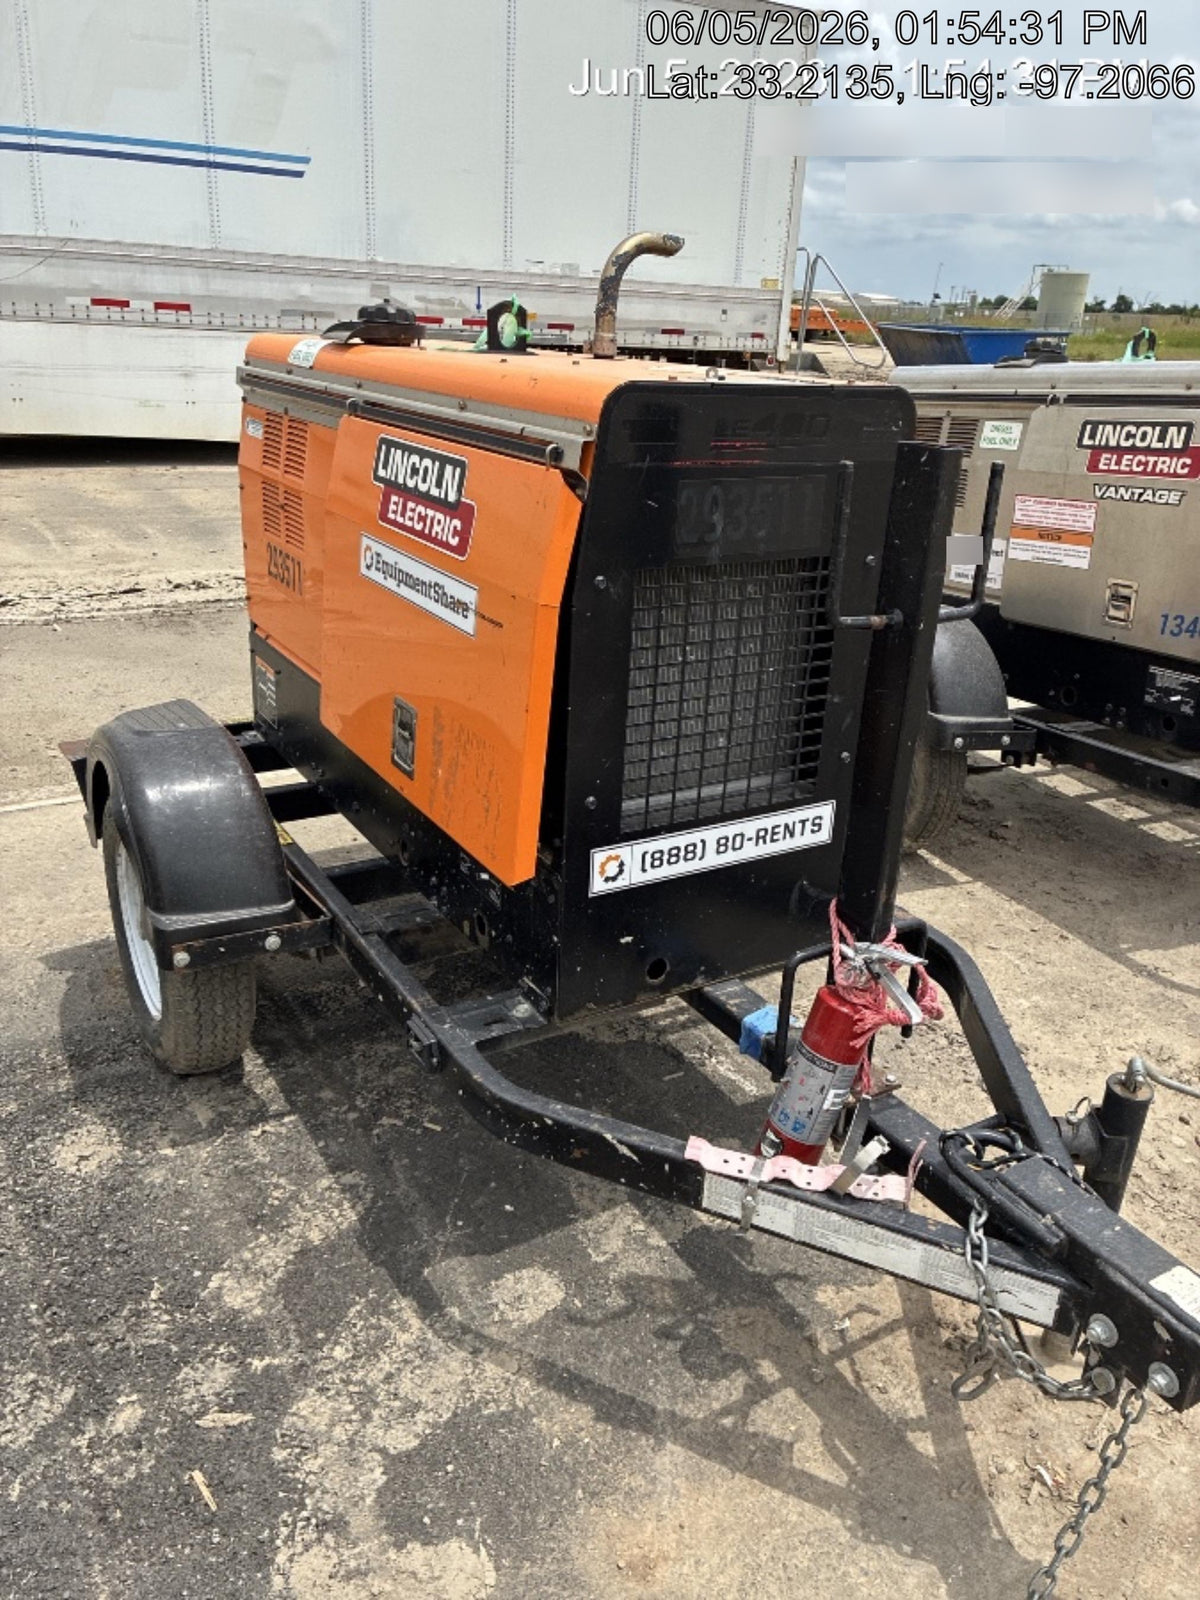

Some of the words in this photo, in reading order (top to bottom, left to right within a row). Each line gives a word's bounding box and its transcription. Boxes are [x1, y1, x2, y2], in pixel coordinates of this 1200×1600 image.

[1082, 424, 1188, 449] LINCOLN
[377, 444, 461, 503] LINCOLN
[1098, 453, 1192, 474] ELECTRIC
[1093, 483, 1185, 505] VANTAGE
[387, 495, 462, 547] ELECTRIC
[374, 551, 470, 619] EquipmentShare
[1160, 613, 1200, 639] 134
[641, 838, 707, 873] (888)
[716, 815, 824, 856] 80-RENTS
